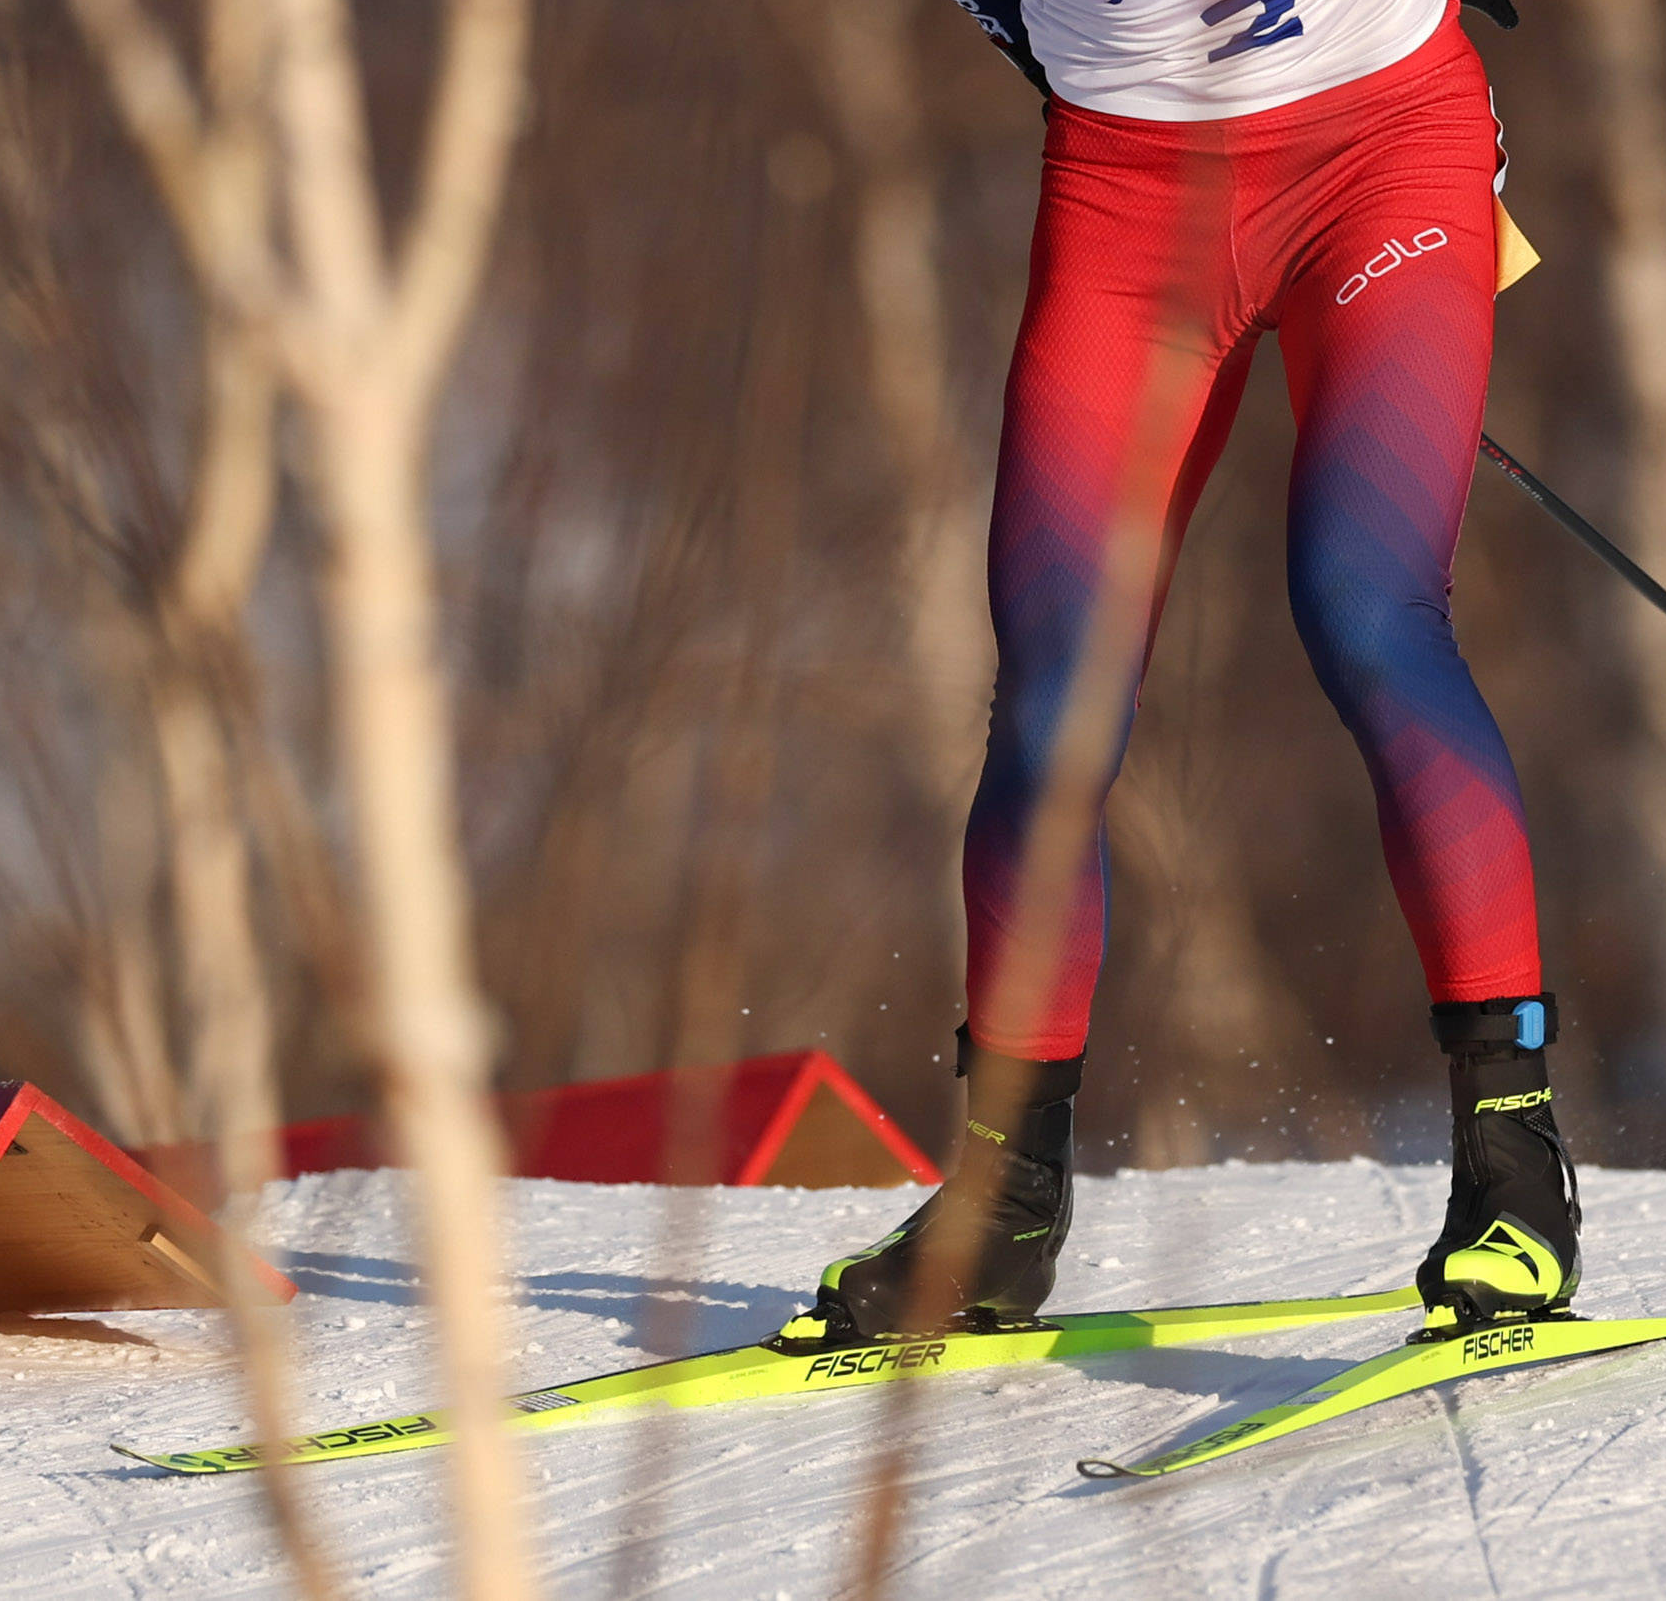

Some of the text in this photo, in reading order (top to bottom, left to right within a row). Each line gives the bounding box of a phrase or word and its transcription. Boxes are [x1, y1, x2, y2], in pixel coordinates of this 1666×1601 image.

[1336, 227, 1448, 305] odlo
[805, 1343, 947, 1382] FISCHER
[1463, 1327, 1535, 1365] FISCHER
[215, 1416, 437, 1463] FISCHR
